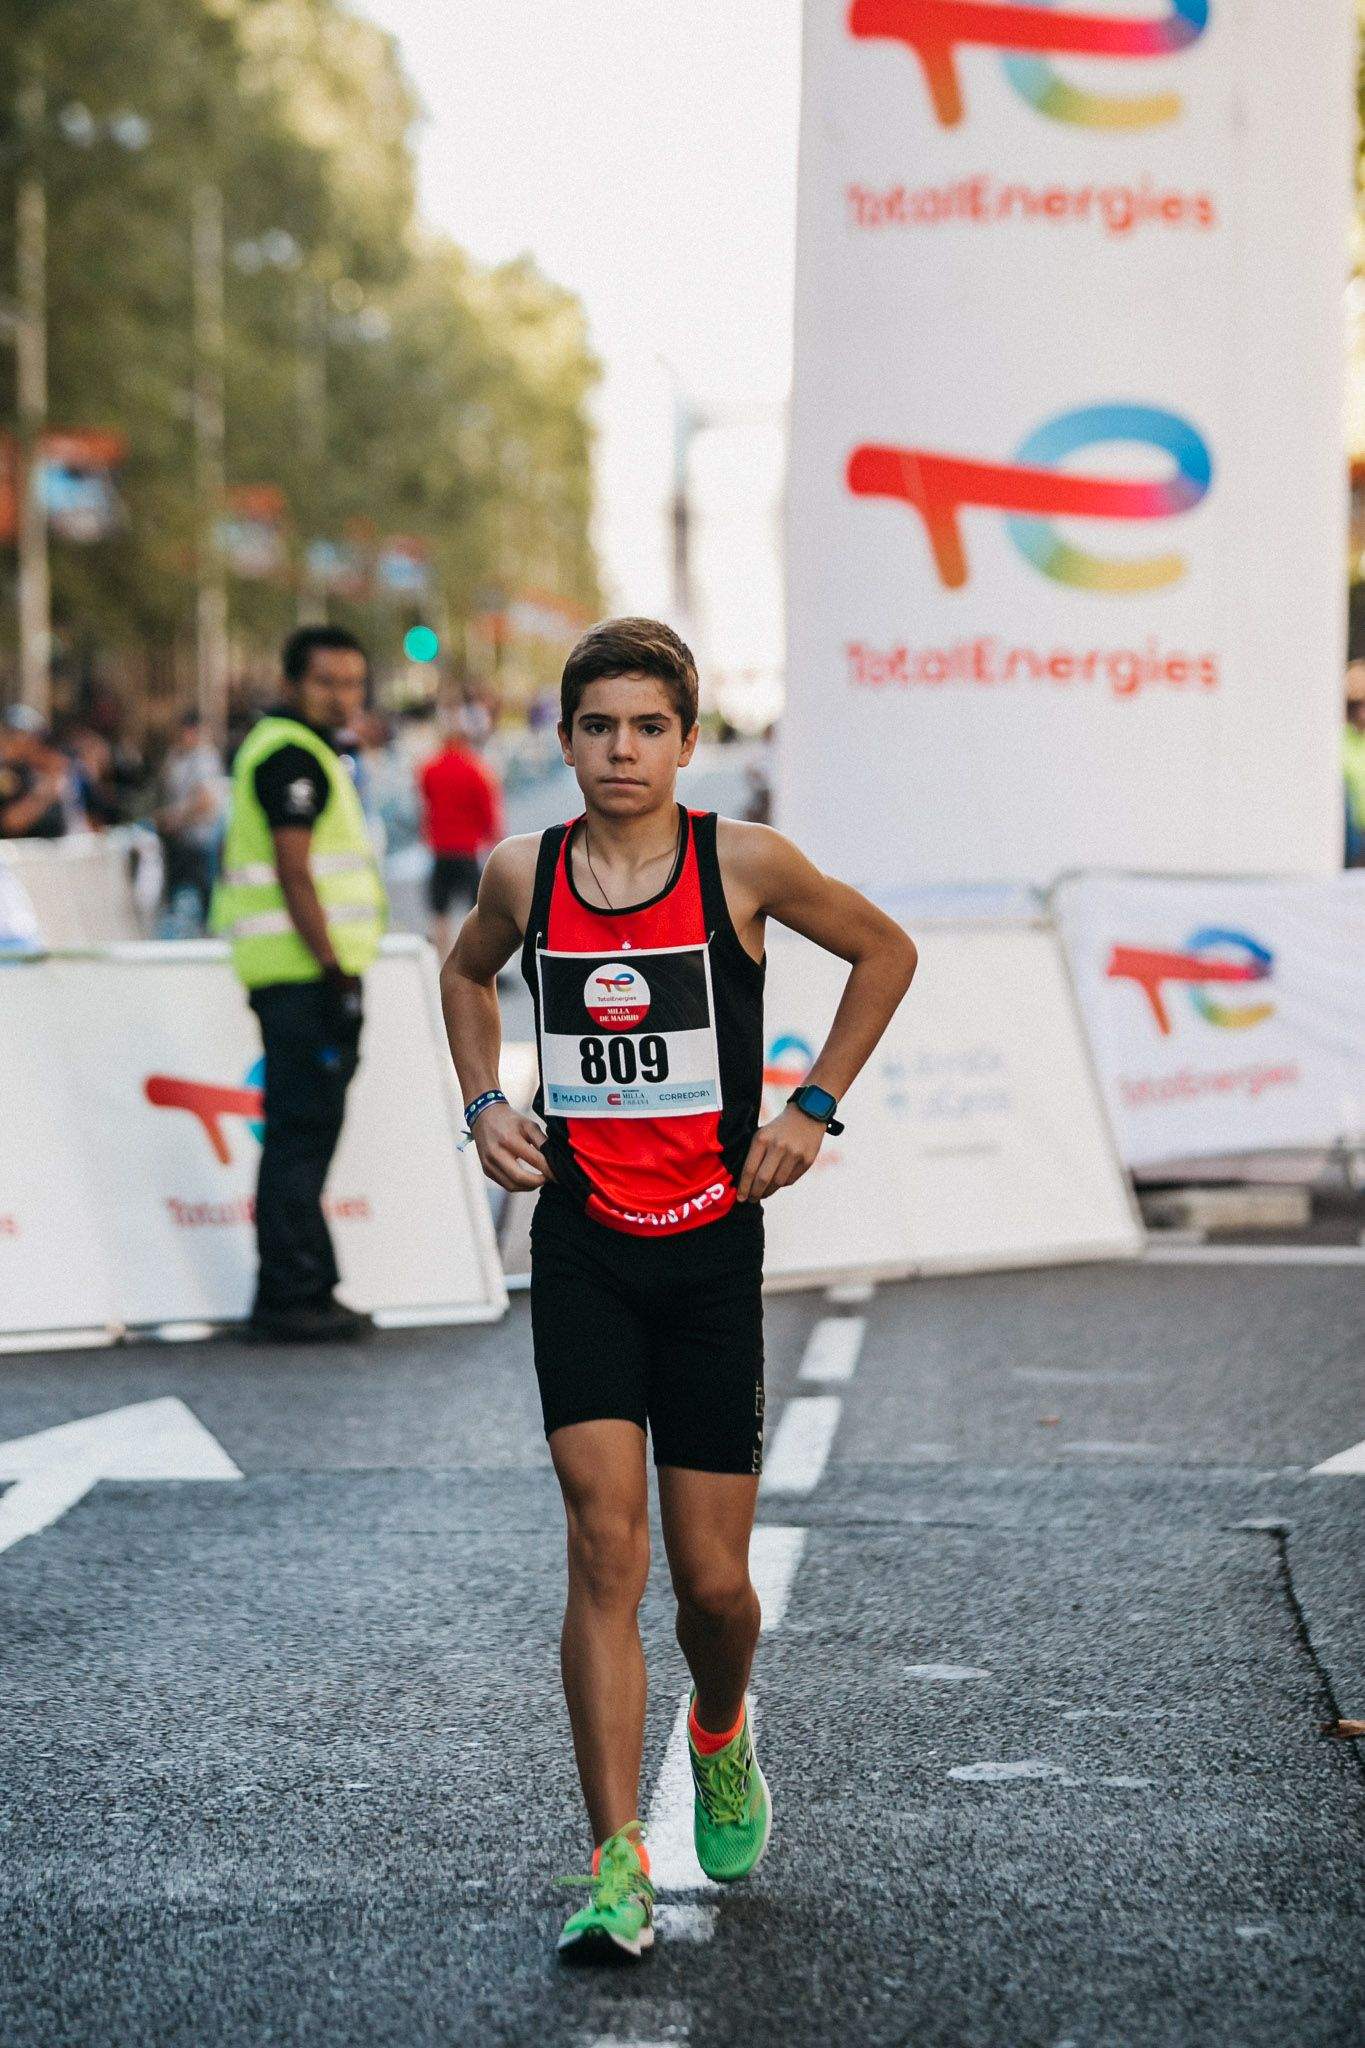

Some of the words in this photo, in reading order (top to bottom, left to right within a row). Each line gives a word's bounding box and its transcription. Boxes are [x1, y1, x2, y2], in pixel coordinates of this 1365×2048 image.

[611, 1014, 639, 1022] MADRID
[579, 1034, 669, 1085] 809
[562, 1093, 598, 1104] MADRID
